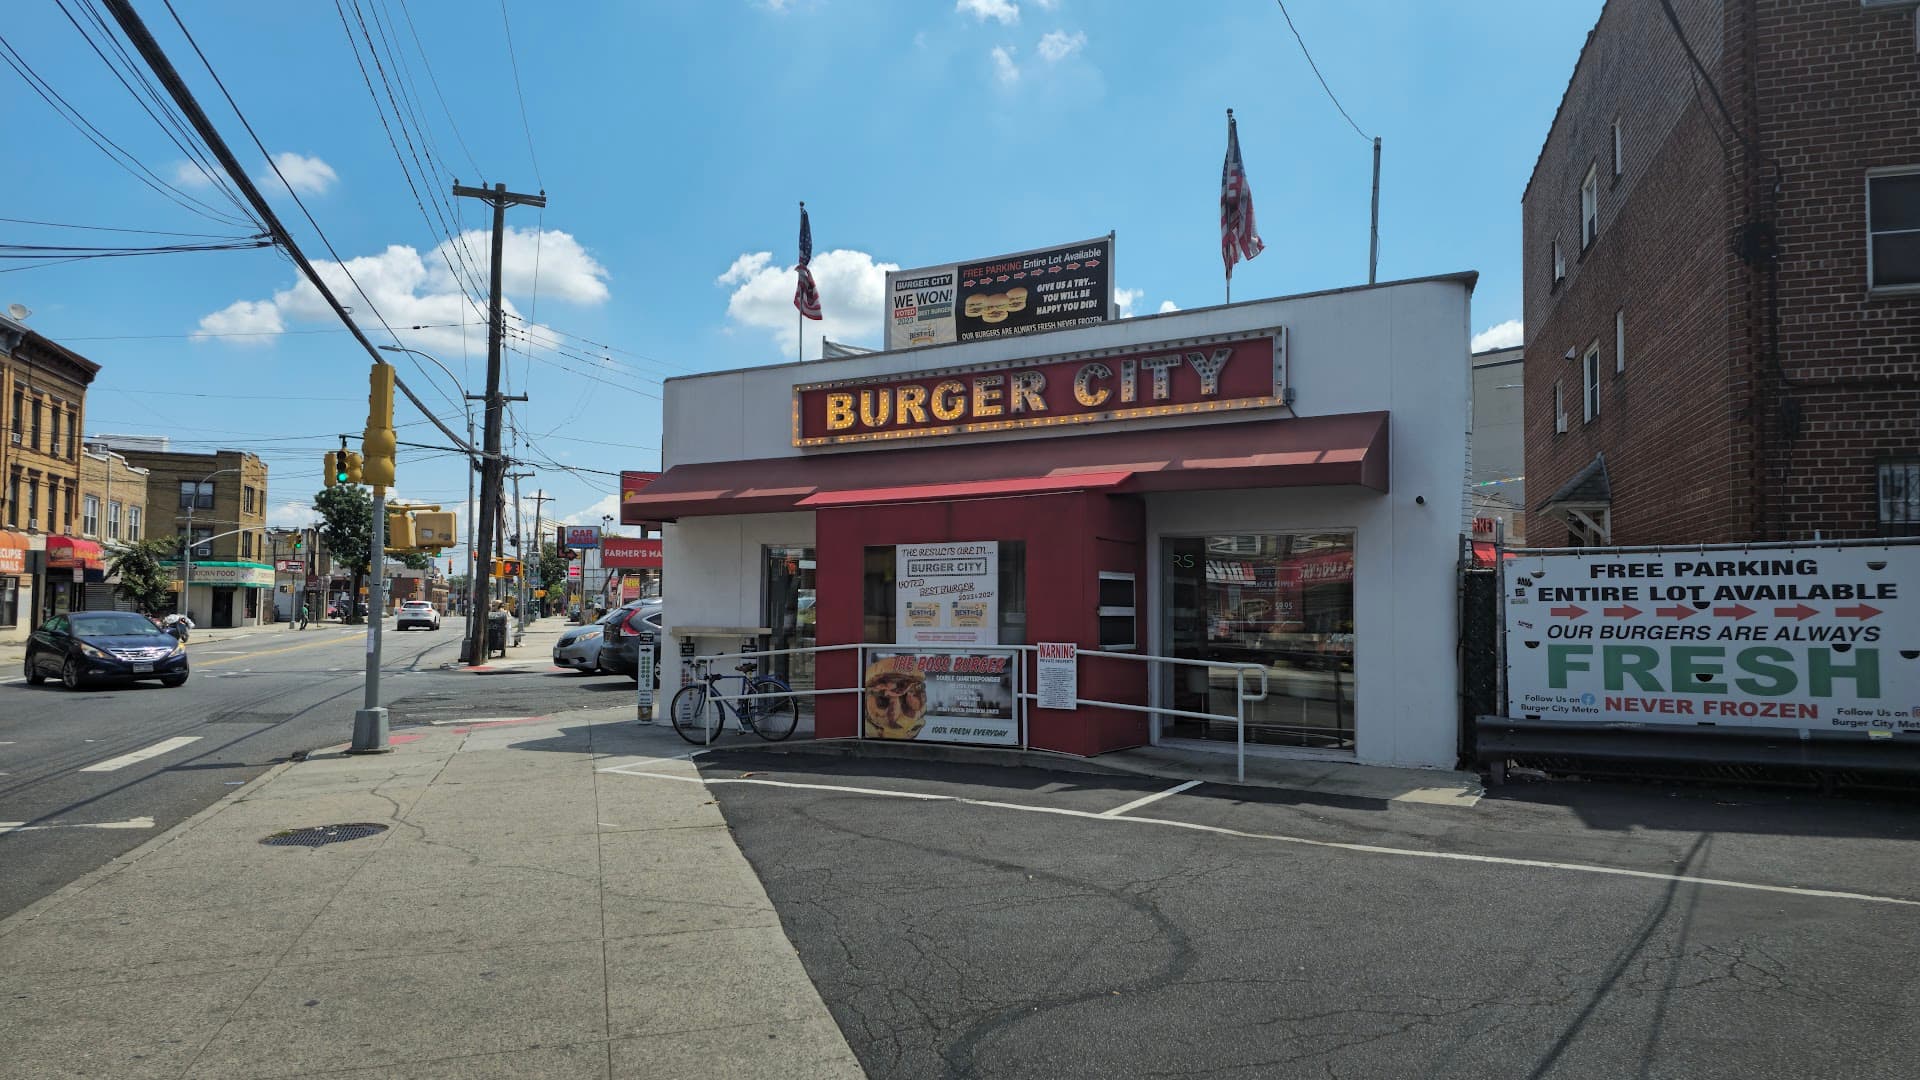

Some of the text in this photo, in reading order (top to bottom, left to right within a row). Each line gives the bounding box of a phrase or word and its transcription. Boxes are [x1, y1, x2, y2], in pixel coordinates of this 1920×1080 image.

[963, 248, 1102, 279] FREE PARKING Entire Lot Available
[896, 275, 951, 290] BURGER CITY
[1037, 283, 1054, 293] GIVE
[1055, 281, 1066, 290] US
[1073, 277, 1097, 288] TRY...
[894, 289, 952, 309] WE WON!
[1043, 289, 1090, 303] YOU WILL BE
[896, 308, 916, 317] VOTED
[1036, 300, 1097, 316] HAPPY YOU DID!
[897, 317, 914, 326] 2023
[962, 316, 1102, 341] OUR BURGERS ARE ALWAYS FRESH NEVER FROZEN
[826, 347, 1232, 431] BURGER CITY
[572, 529, 593, 537] CAR
[605, 549, 647, 558] FARMER'S
[902, 548, 918, 557] THE
[919, 547, 957, 557] RESULTS
[957, 546, 975, 555] ARE
[911, 562, 982, 573] BURGER CITY
[1590, 559, 1818, 579] FREE PARKING
[898, 578, 925, 589] VOTED
[940, 583, 975, 594] BURGER
[1538, 586, 1638, 602] ENTIRE
[1650, 585, 1705, 602] LOT
[1714, 583, 1897, 601] AVAILABLE
[1547, 625, 1881, 642] OUR BURGERS ARE ALWAYS
[1039, 644, 1075, 659] WARNING
[892, 656, 1007, 674] THE BOSS BURGER
[1547, 644, 1881, 699] FRESH
[1525, 694, 1553, 703] Follow
[1556, 695, 1567, 703] Us
[1521, 704, 1599, 714] Burger City Metro
[1605, 697, 1818, 719] NEVER FROZEN
[1837, 707, 1873, 716] Follow
[1877, 709, 1891, 717] Us
[1832, 718, 1868, 728] Burger
[1872, 719, 1893, 729] City
[931, 725, 1008, 738] 100% FRESH EVERYDAY
